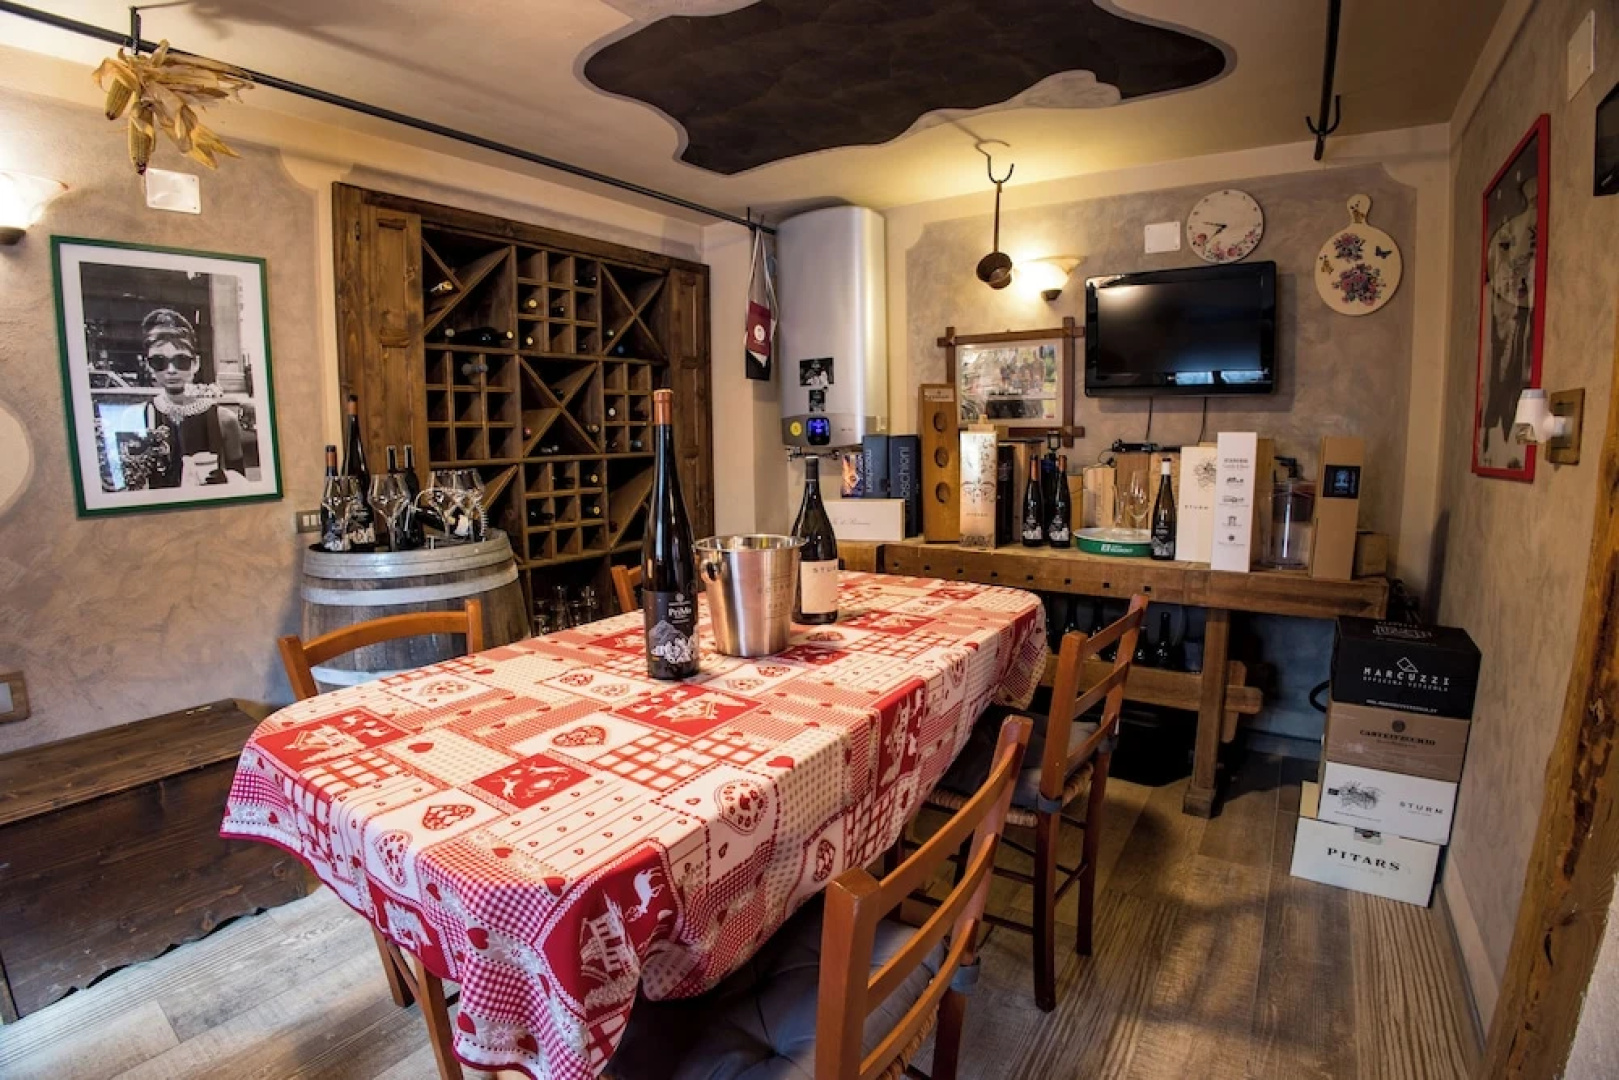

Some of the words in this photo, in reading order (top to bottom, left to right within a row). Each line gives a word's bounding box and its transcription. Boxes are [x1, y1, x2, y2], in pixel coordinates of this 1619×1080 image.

[1362, 666, 1450, 686] MARCUZZI
[1399, 801, 1444, 814] STURM
[1327, 847, 1400, 871] PITARS
